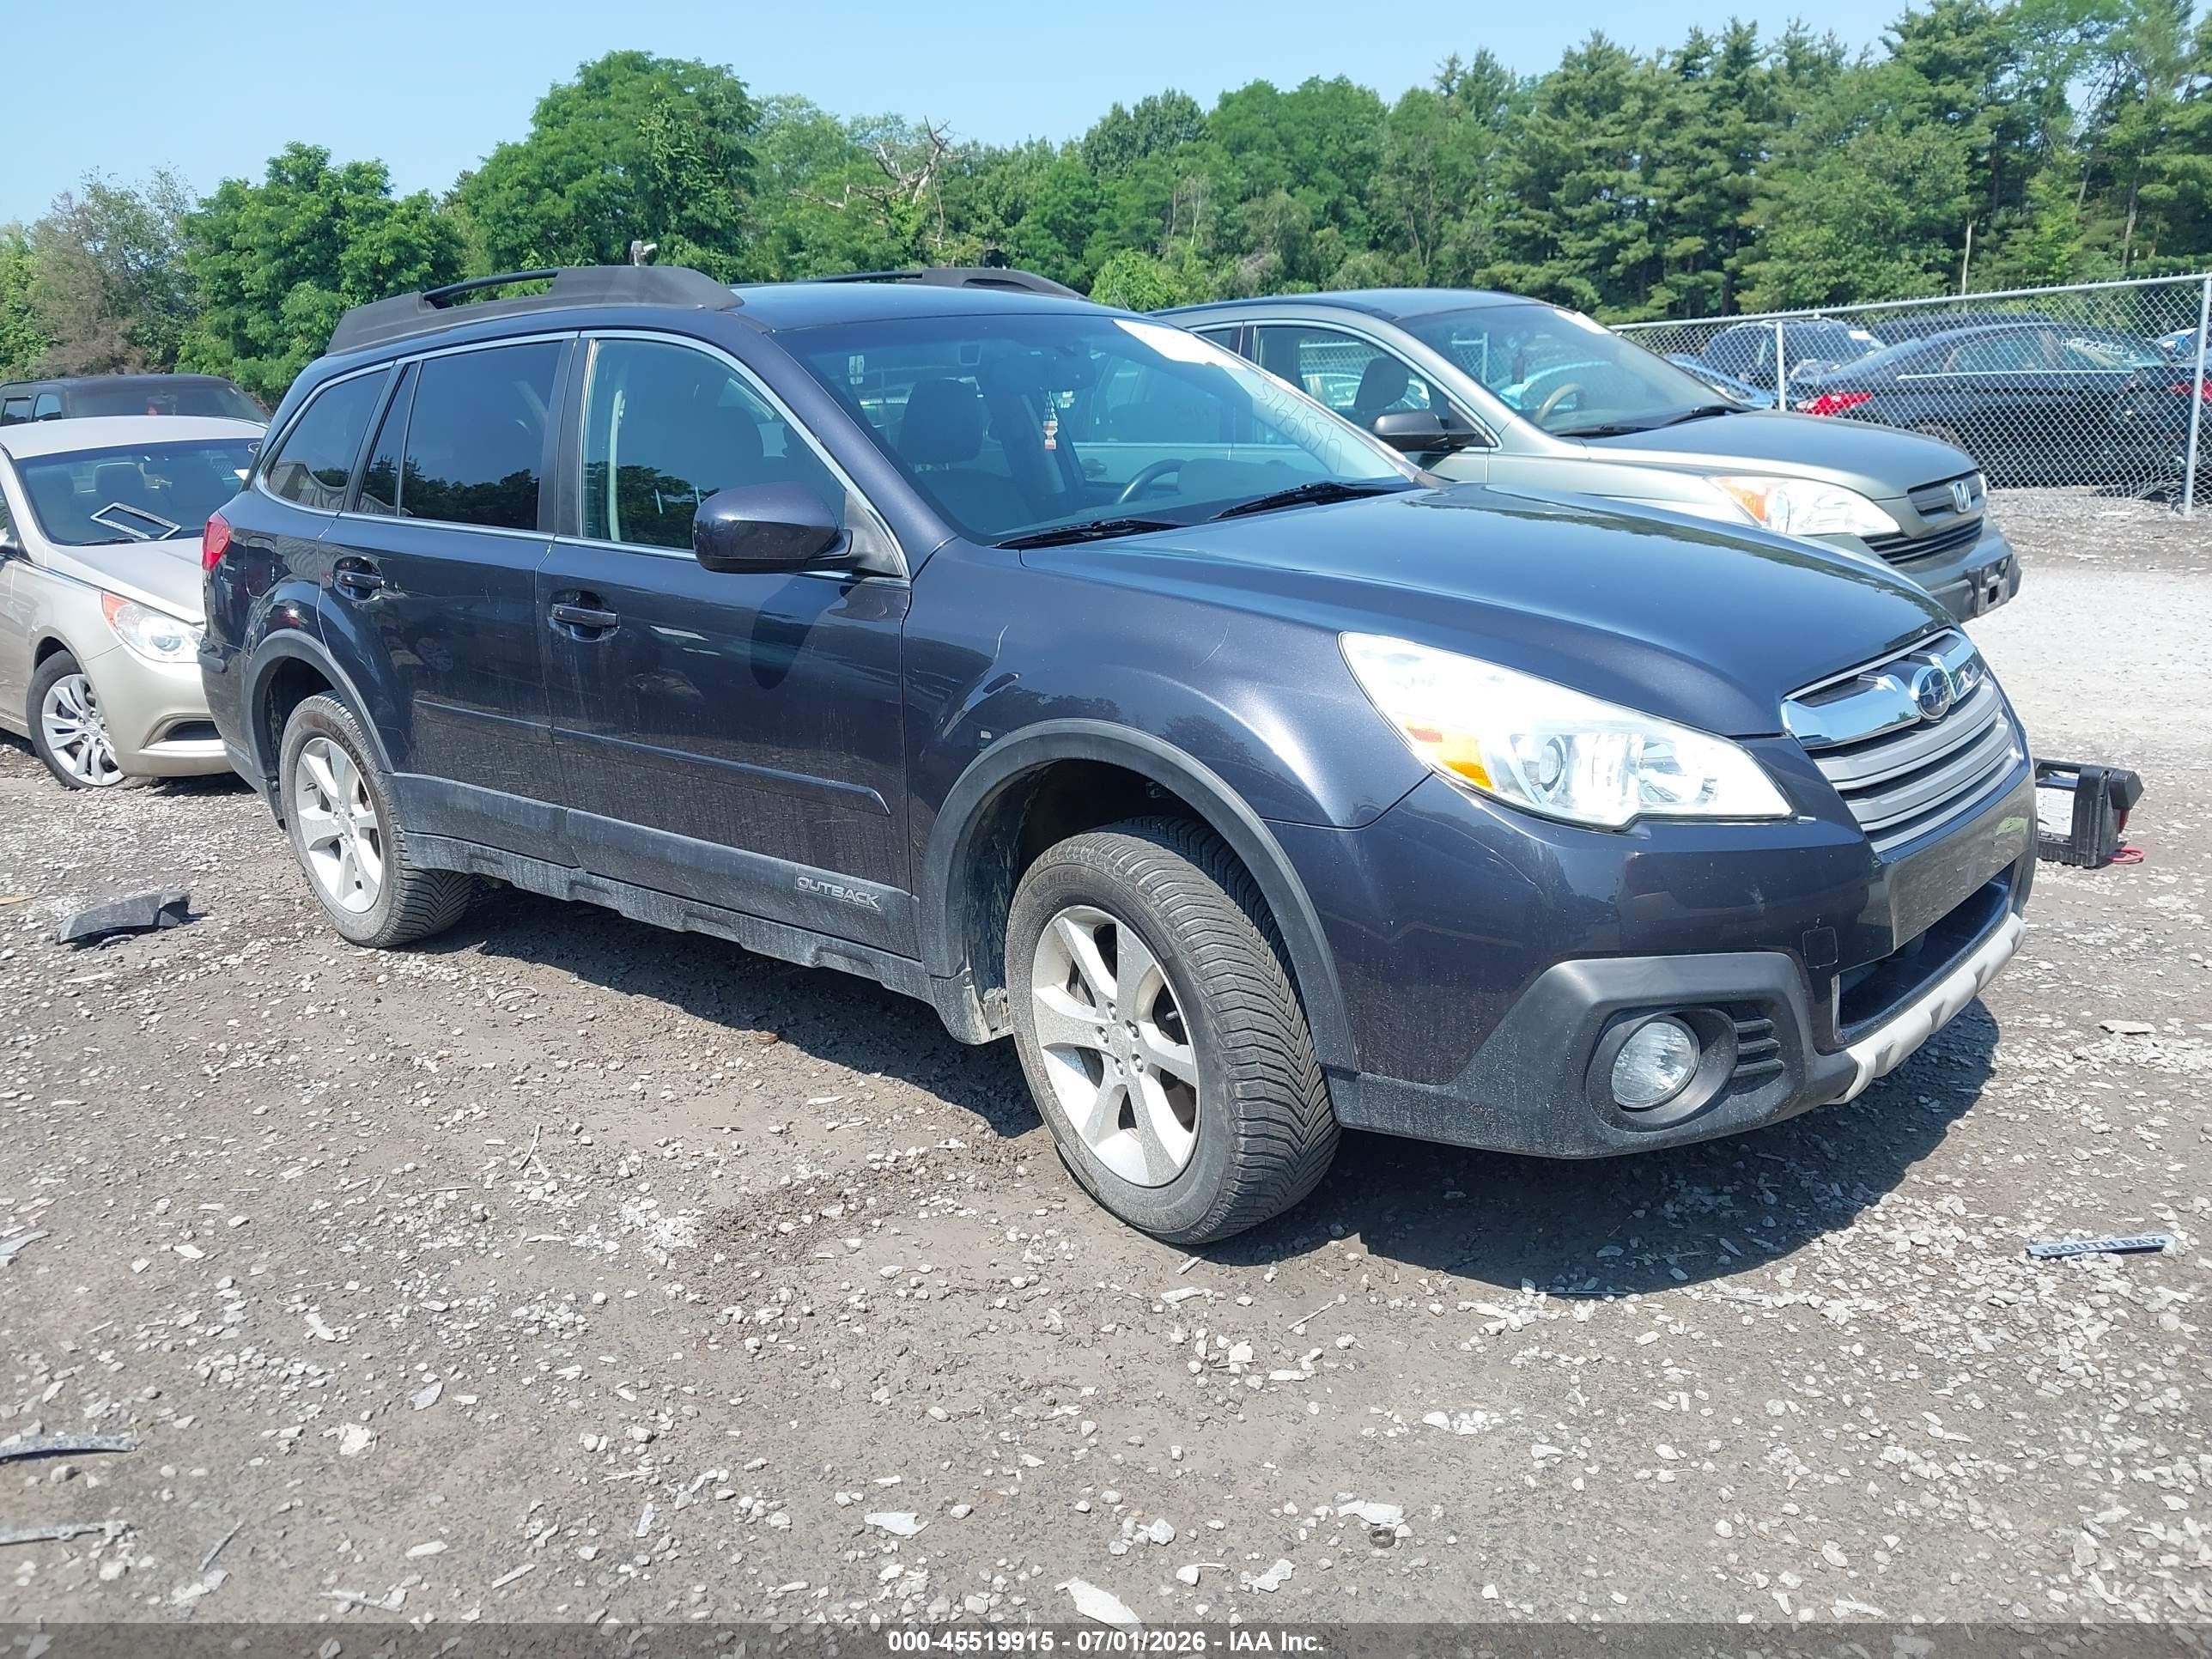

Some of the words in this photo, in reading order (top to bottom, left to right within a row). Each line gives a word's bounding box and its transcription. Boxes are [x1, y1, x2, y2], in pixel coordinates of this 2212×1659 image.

[797, 877, 880, 908] OUTBACK
[2048, 1241, 2115, 1254] SOUTH
[2123, 1237, 2158, 1247] BAY
